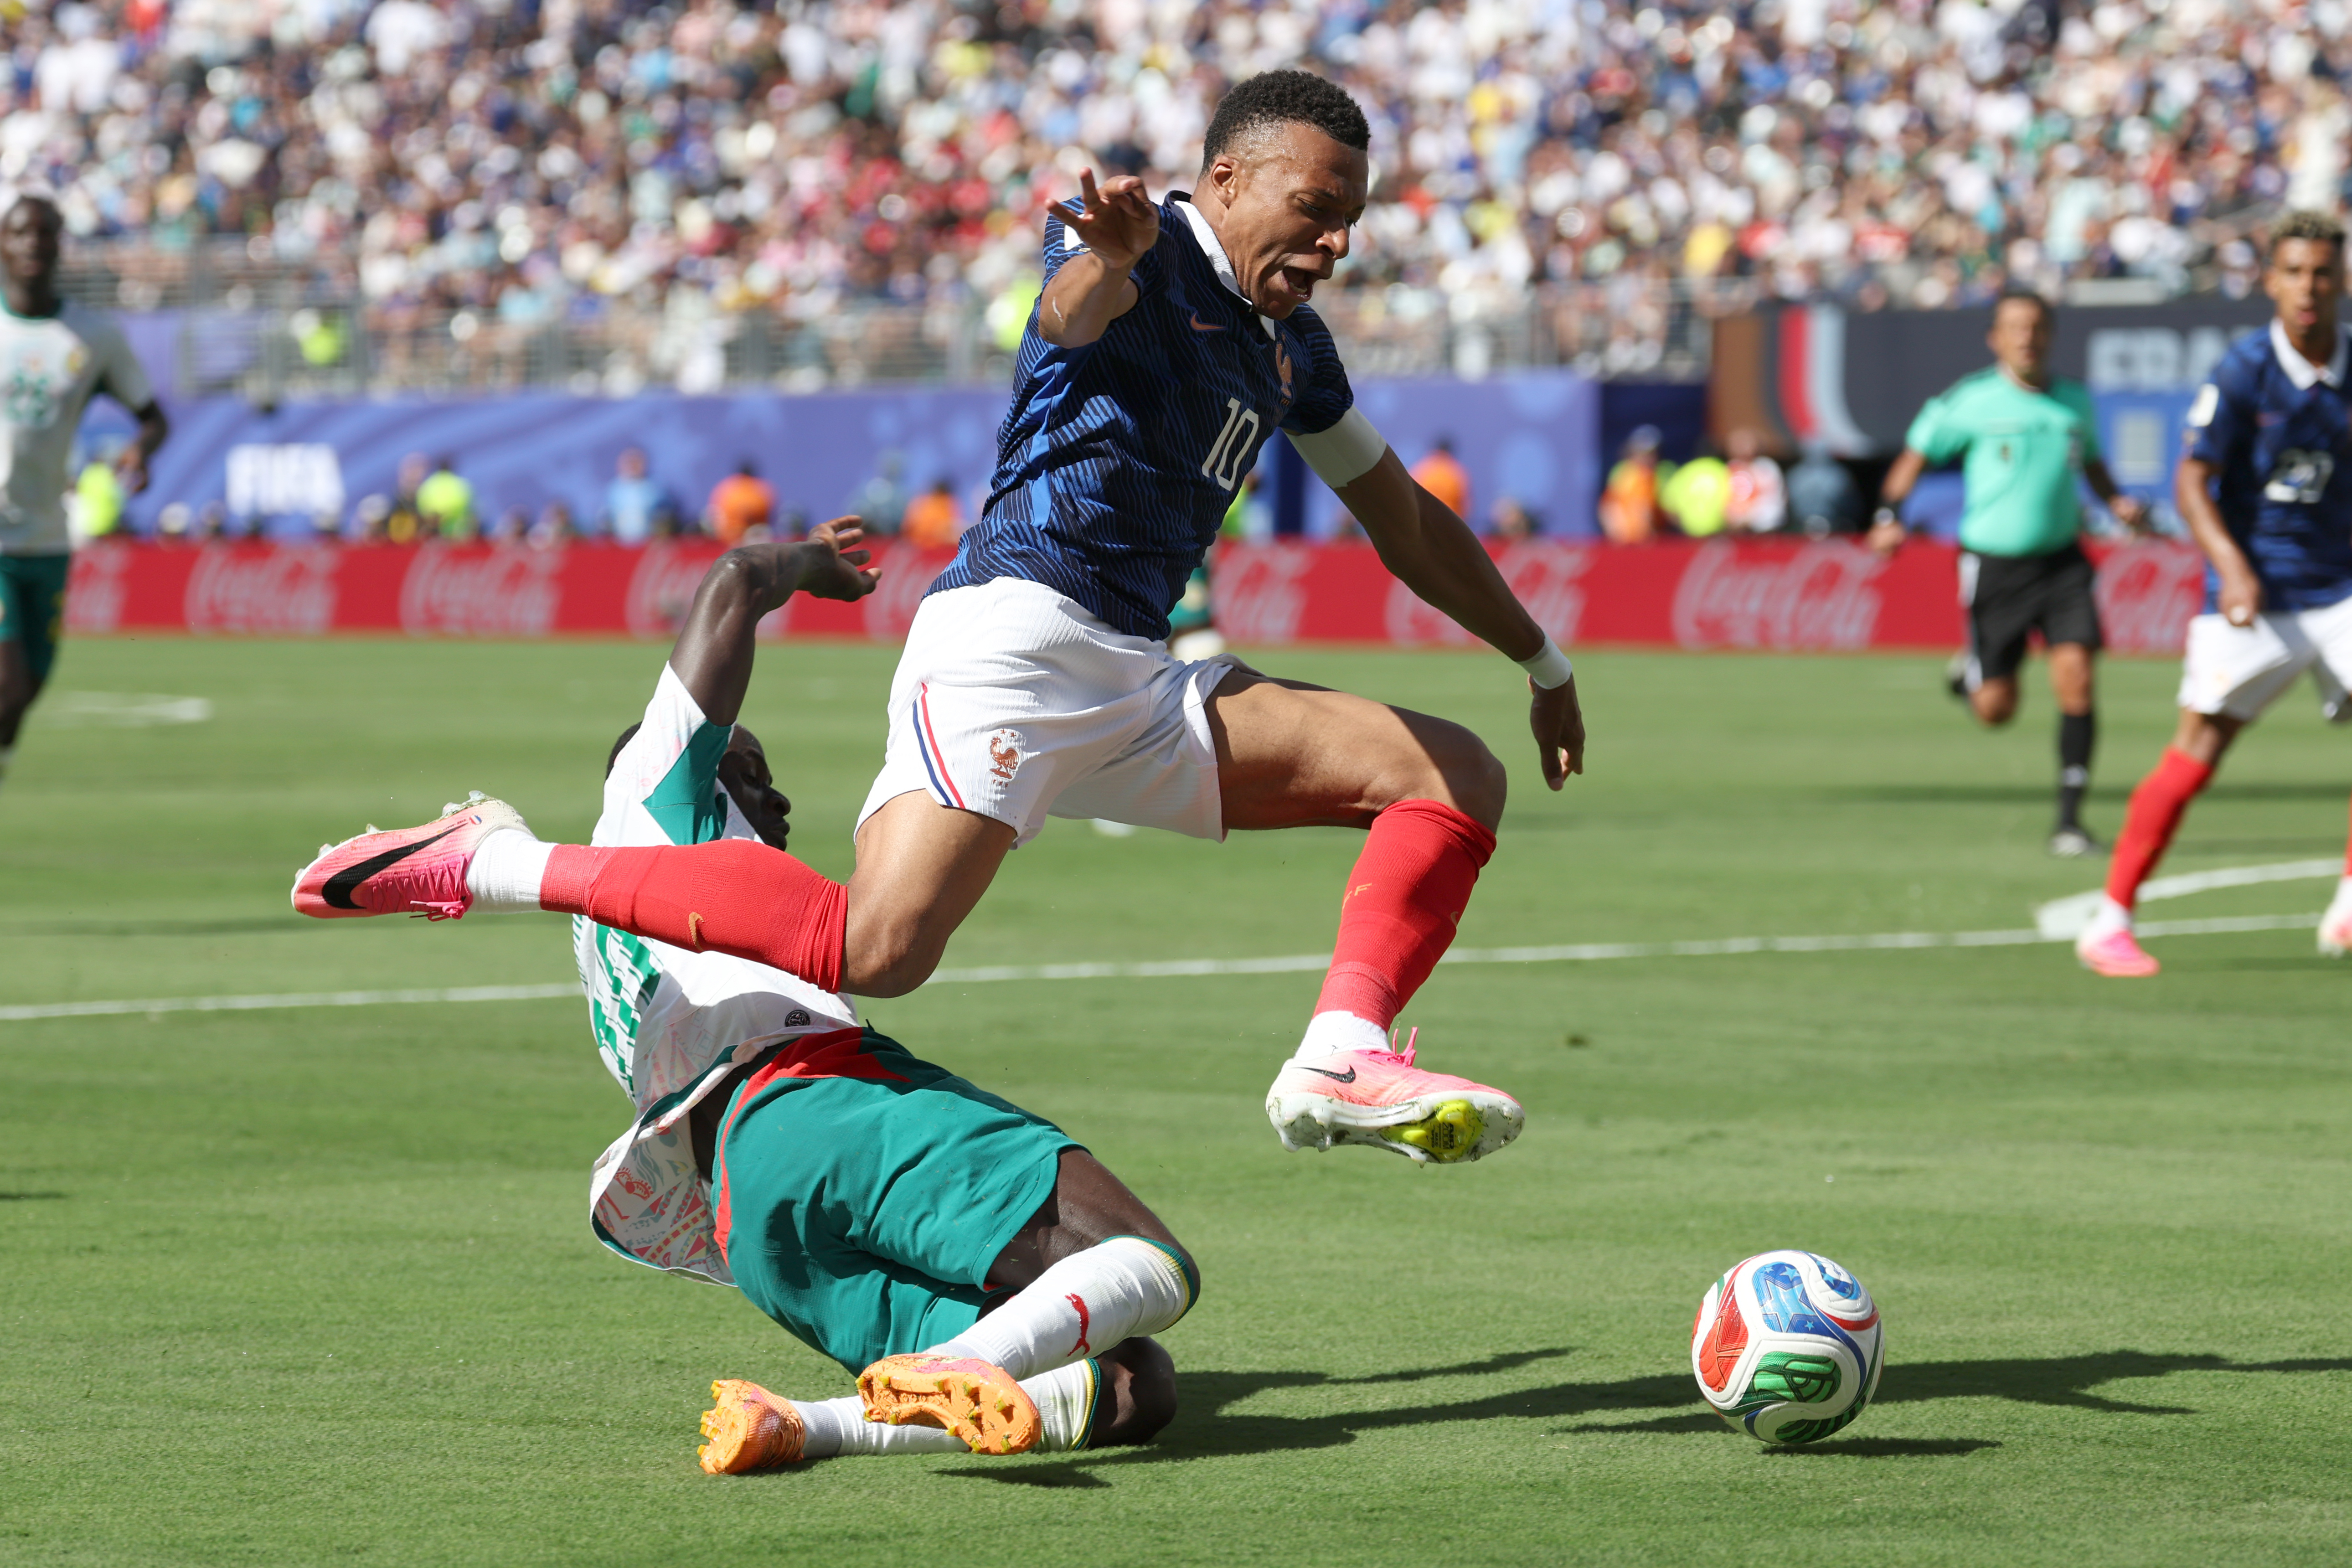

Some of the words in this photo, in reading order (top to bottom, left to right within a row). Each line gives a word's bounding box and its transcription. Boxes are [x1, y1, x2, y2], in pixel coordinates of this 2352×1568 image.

[2087, 327, 2259, 395] FRA
[226, 442, 346, 516] FIFA
[1202, 397, 1259, 492] 10
